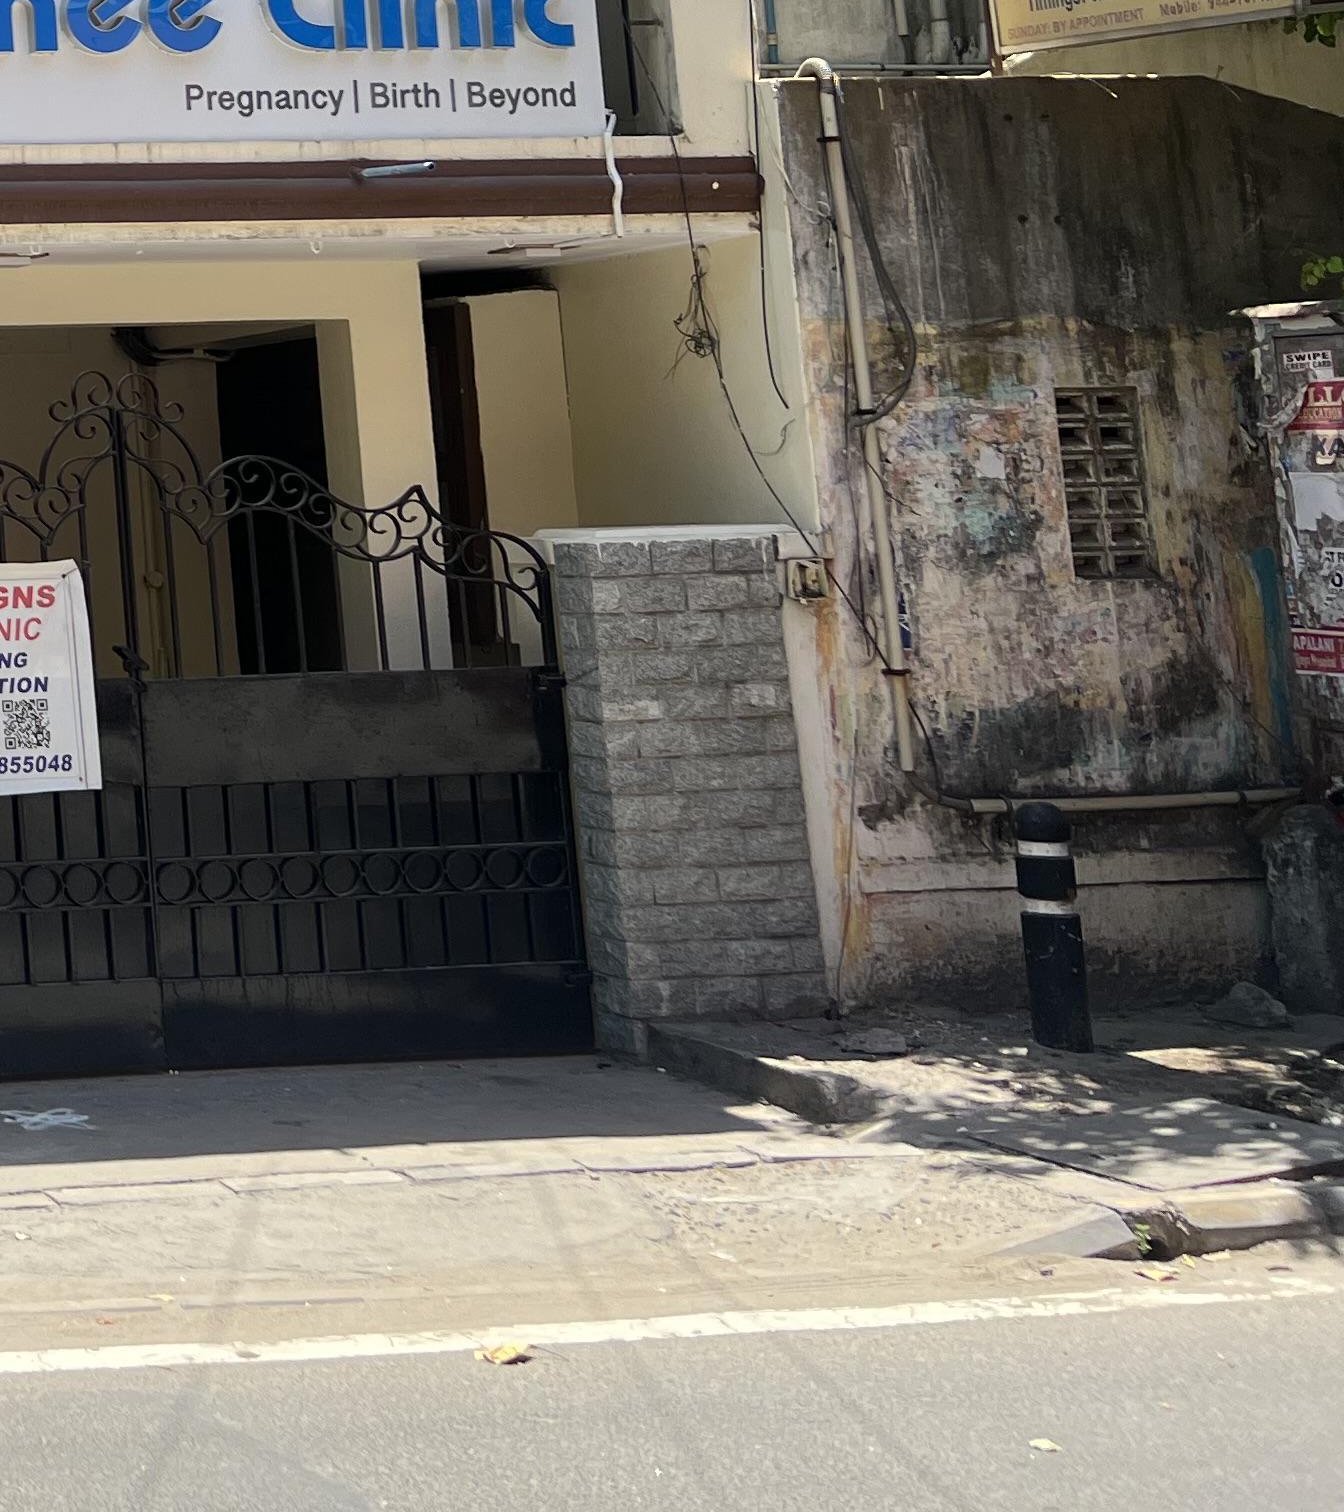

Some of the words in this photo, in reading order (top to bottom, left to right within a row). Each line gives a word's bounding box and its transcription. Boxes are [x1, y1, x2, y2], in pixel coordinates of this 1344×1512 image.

[1052, 21, 1067, 34] BY
[1068, 7, 1145, 31] APPOINTMENT
[185, 84, 344, 118] Pregnancy
[370, 82, 441, 108] Birth
[466, 81, 577, 114] Beyond
[1286, 351, 1329, 363] SWIPE
